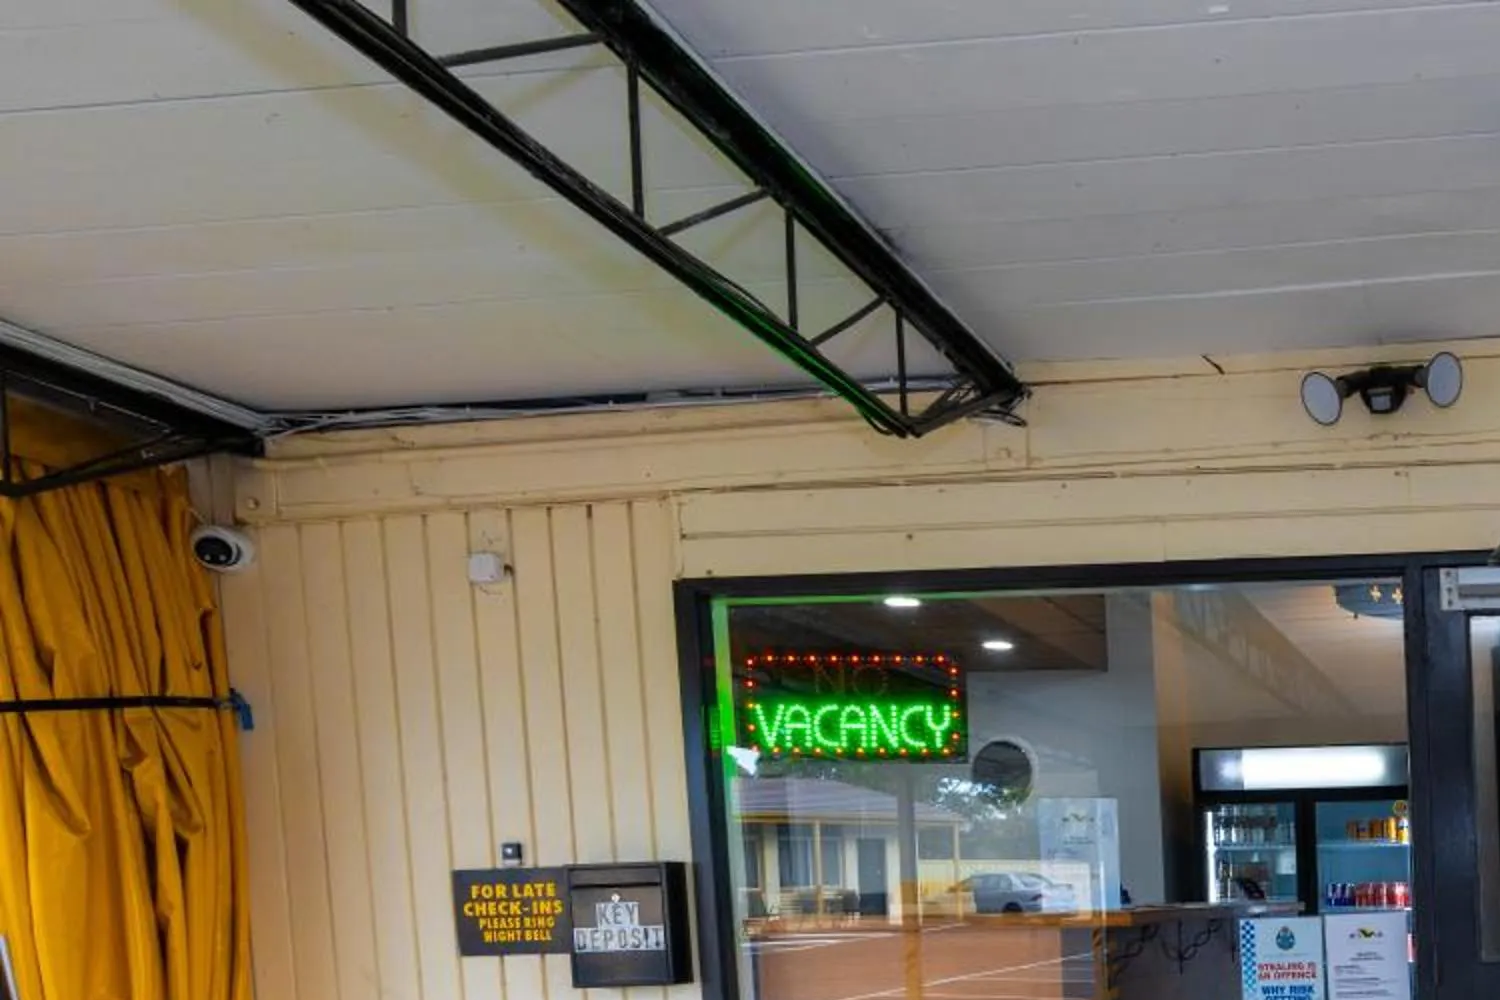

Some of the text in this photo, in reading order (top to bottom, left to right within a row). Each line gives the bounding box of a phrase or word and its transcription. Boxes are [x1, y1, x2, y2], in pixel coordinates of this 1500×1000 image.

[814, 663, 889, 697] NO
[754, 703, 951, 749] VACANCY
[471, 883, 557, 899] FOR LATE
[463, 899, 563, 917] CHECK-INS
[598, 904, 639, 926] KEY
[479, 916, 555, 930] PLEASE RING
[483, 929, 552, 943] NIGHT BELL
[575, 928, 664, 951] DEPOSIT
[1257, 962, 1304, 971] STEALING
[1258, 971, 1317, 981] AN OFFENCE
[1261, 984, 1315, 996] WHY RISK
